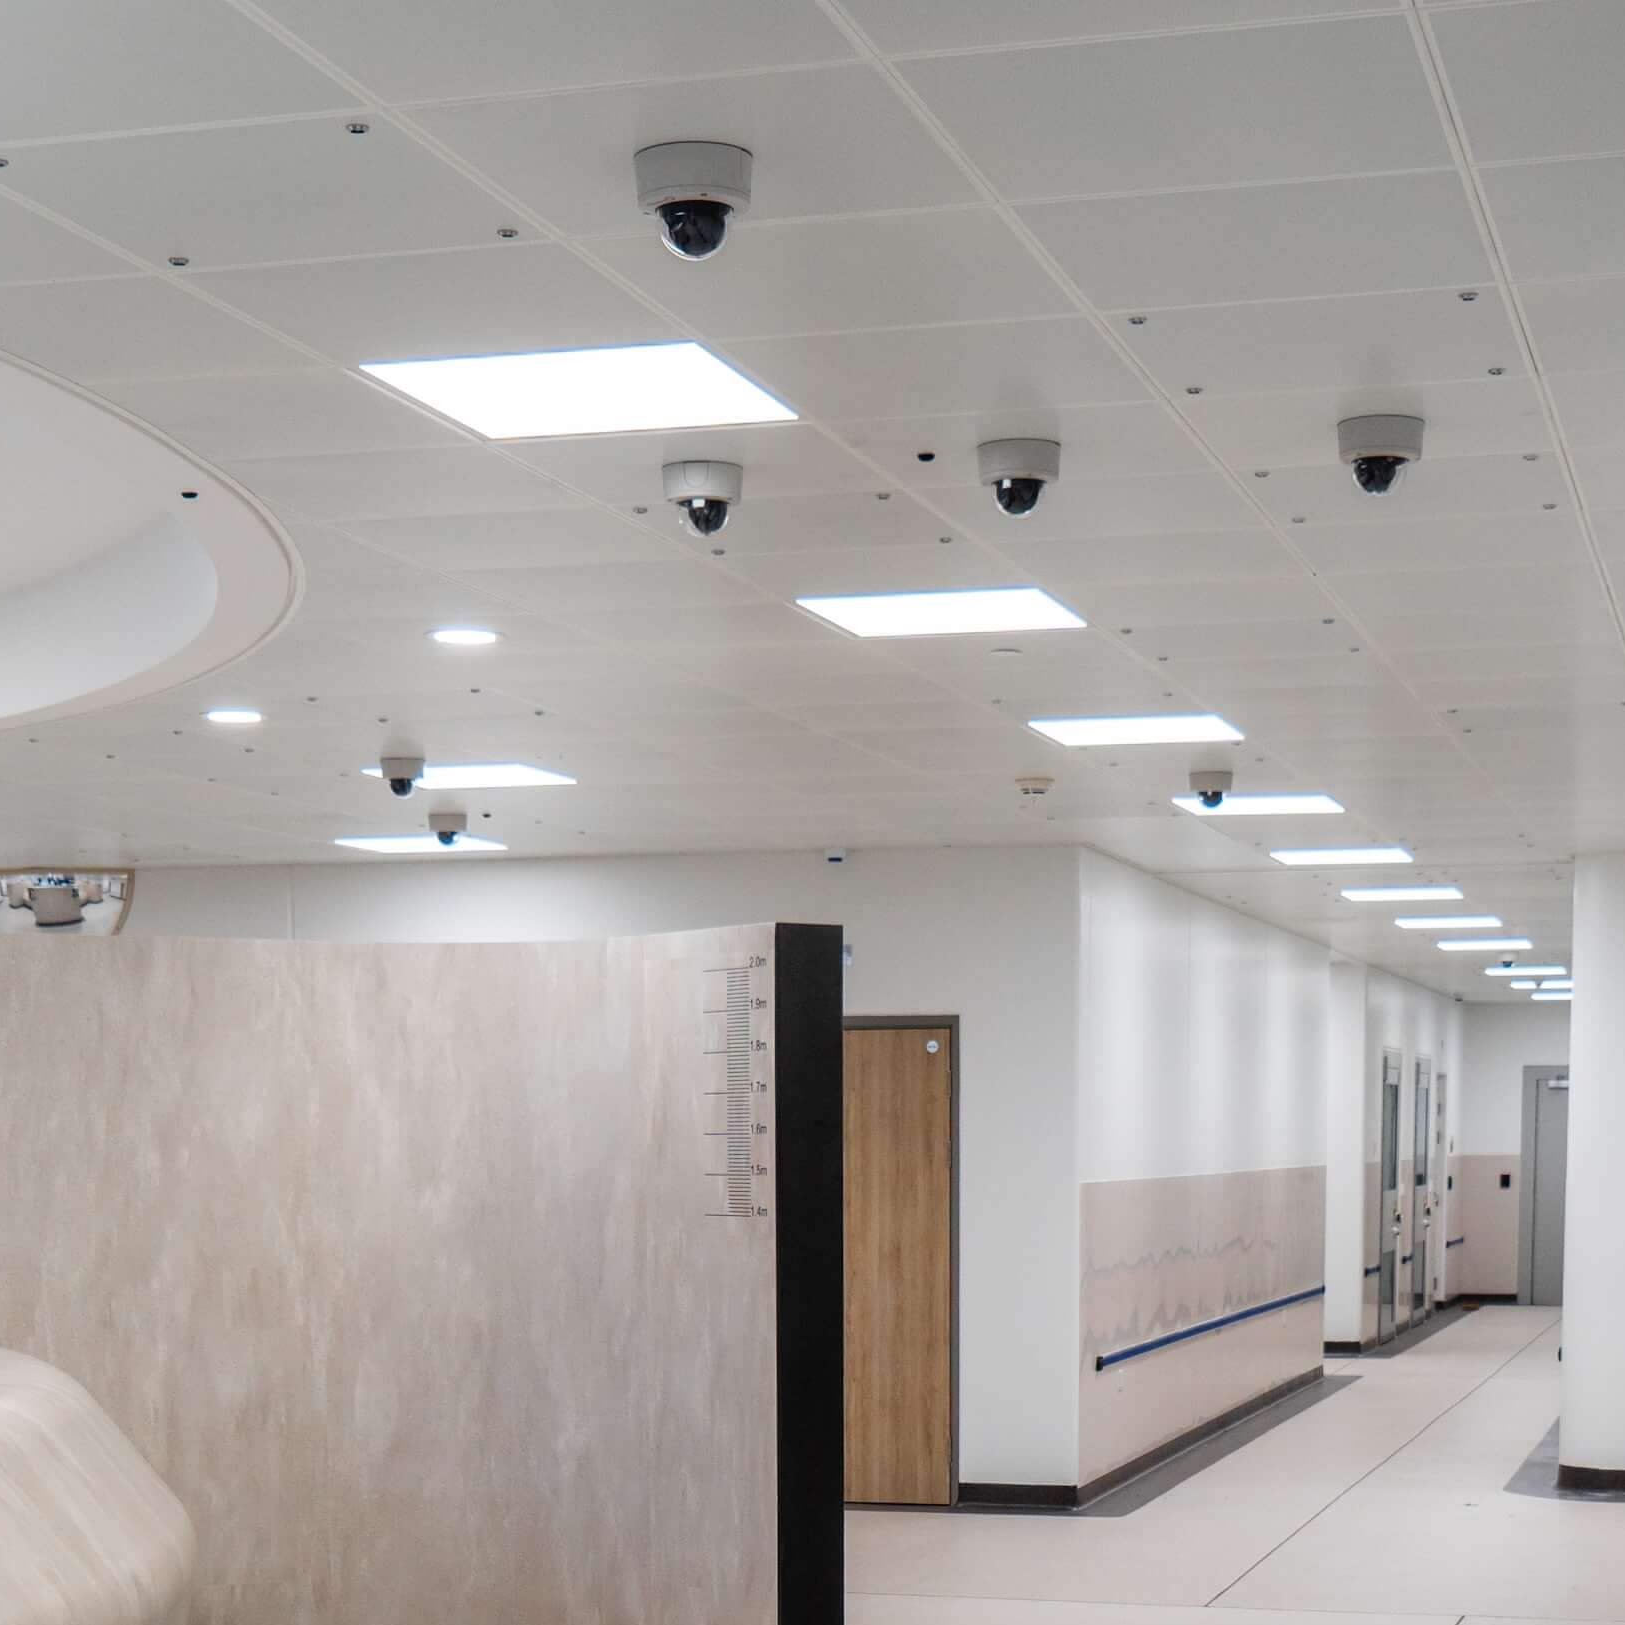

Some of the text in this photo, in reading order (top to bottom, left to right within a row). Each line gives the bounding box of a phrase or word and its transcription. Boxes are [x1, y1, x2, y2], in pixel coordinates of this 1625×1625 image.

[749, 956, 767, 968] 2.0m
[750, 998, 767, 1010] 1.9m
[750, 1040, 767, 1051] 1.8m
[750, 1081, 767, 1093] 1.7m
[750, 1123, 767, 1135] 1.6m
[750, 1164, 768, 1176] 1.5m
[750, 1205, 768, 1217] 1.4m
